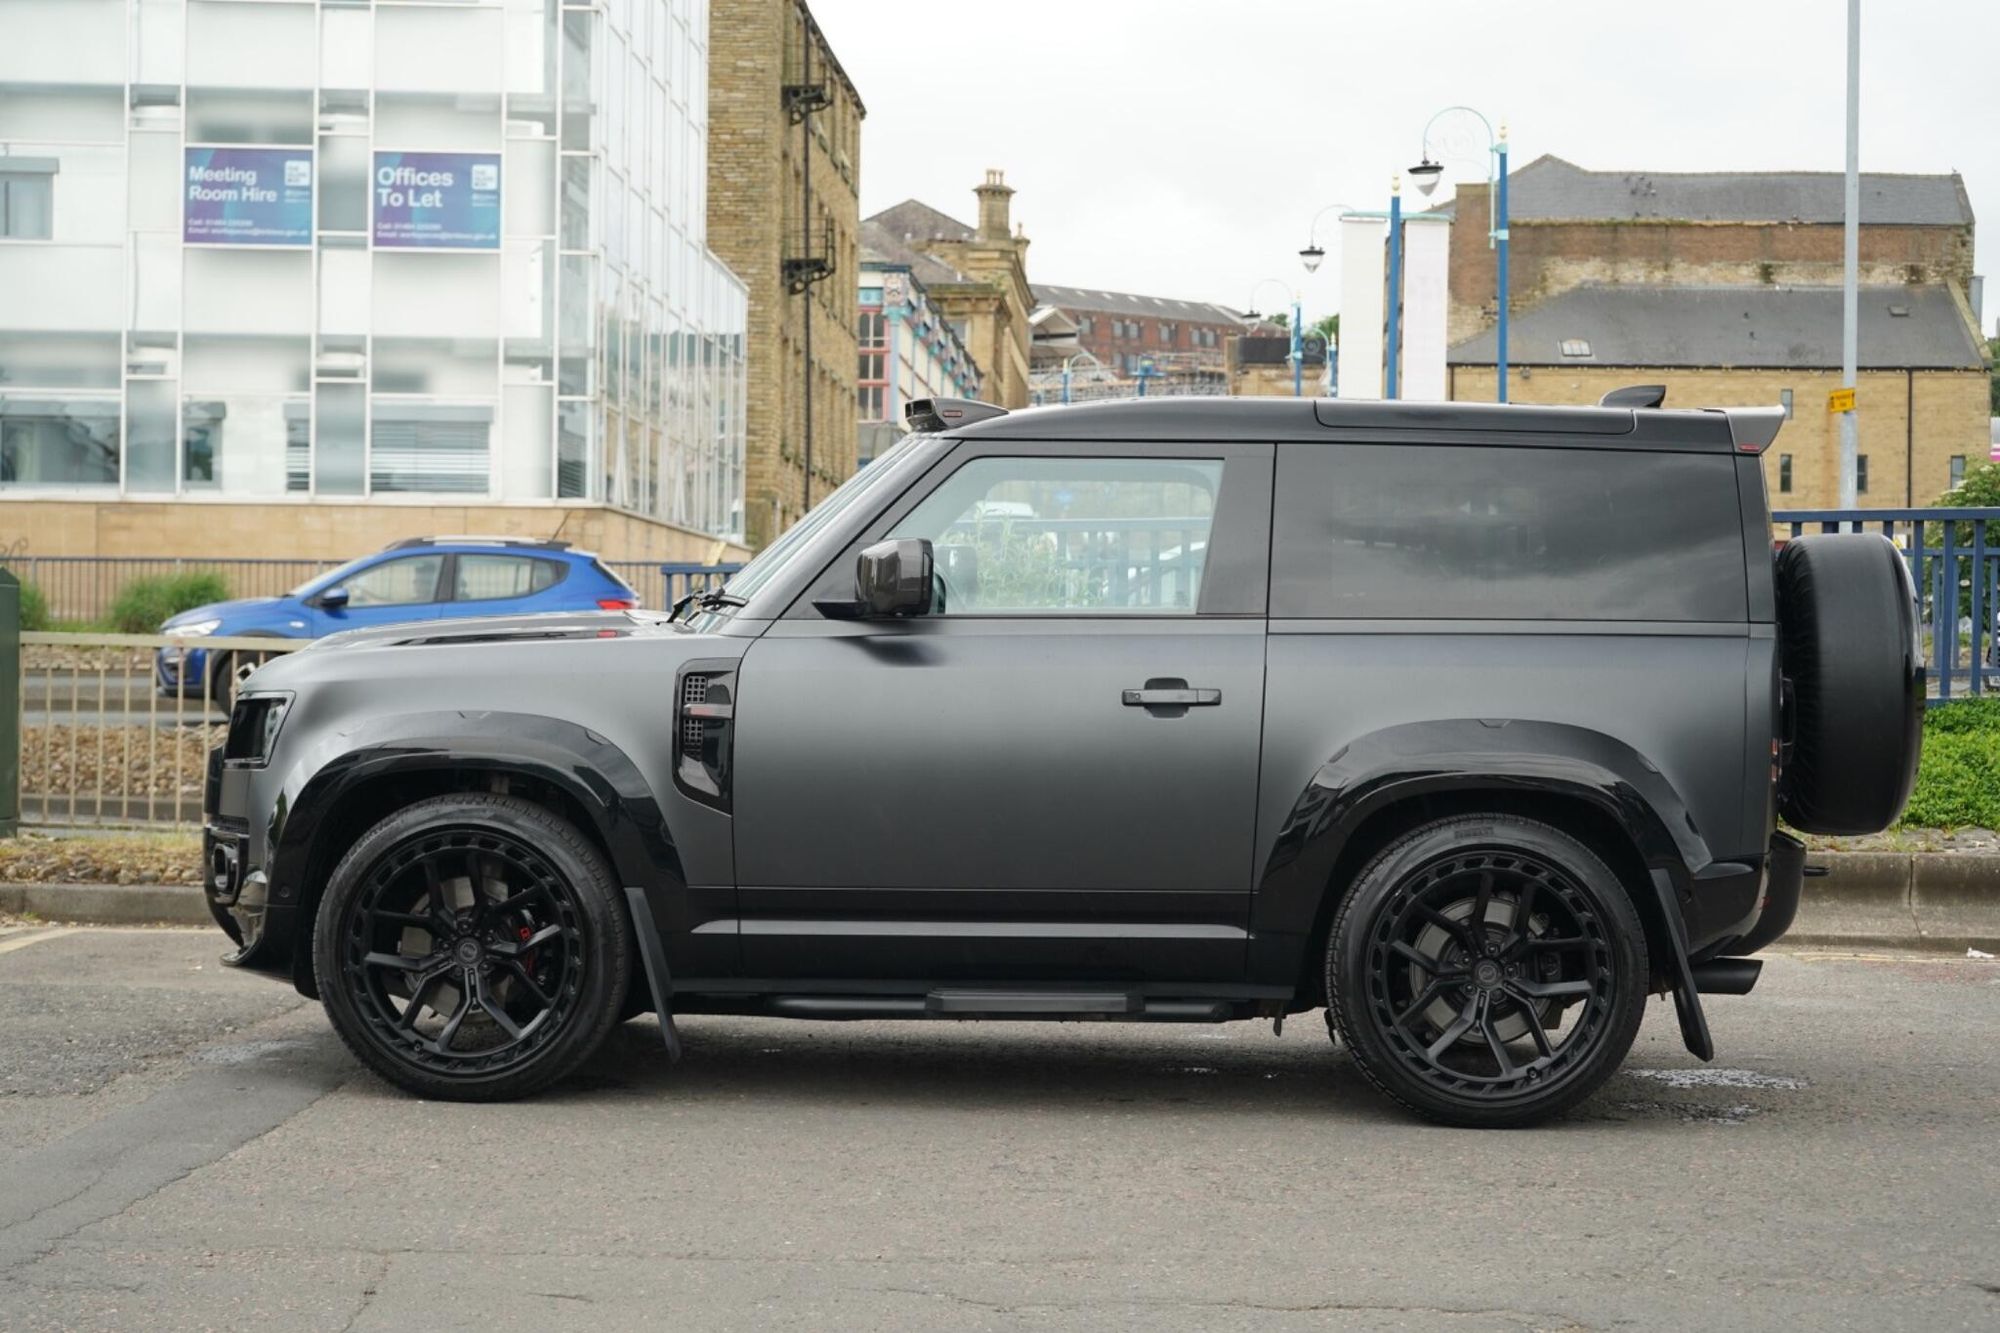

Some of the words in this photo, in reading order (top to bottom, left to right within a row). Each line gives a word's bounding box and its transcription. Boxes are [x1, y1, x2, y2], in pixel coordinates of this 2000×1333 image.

[188, 165, 257, 186] Meeting
[377, 166, 454, 187] Offices
[188, 185, 239, 201] Room
[241, 187, 278, 203] Hire
[377, 188, 404, 207] To
[408, 188, 443, 208] Let
